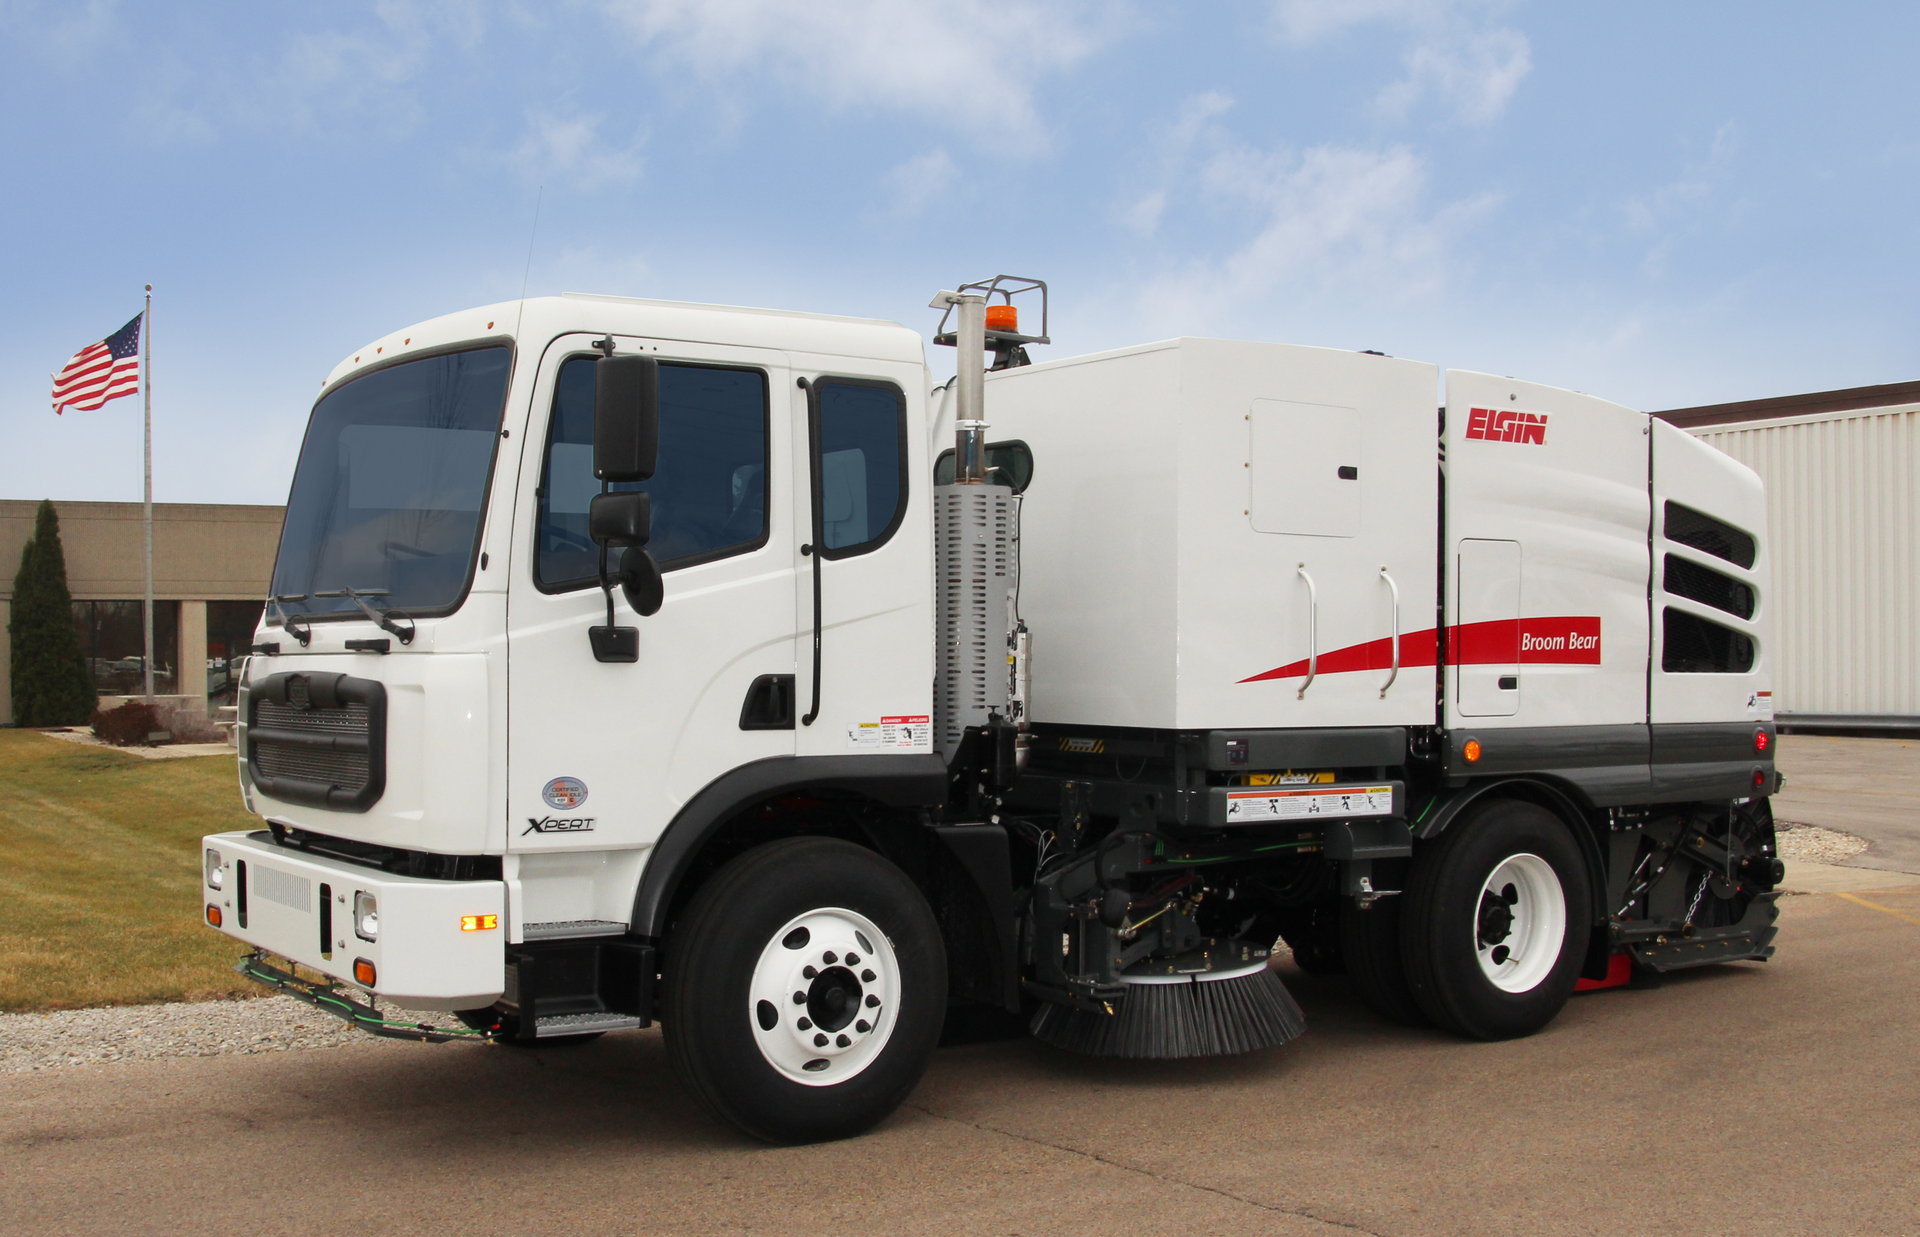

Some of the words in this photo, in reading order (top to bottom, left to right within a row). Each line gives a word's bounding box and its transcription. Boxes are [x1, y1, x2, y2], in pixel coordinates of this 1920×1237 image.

[1465, 407, 1548, 445] ELGIN
[1521, 632, 1565, 651] Broom
[1569, 631, 1598, 650] Bear
[521, 815, 595, 836] XPERT
